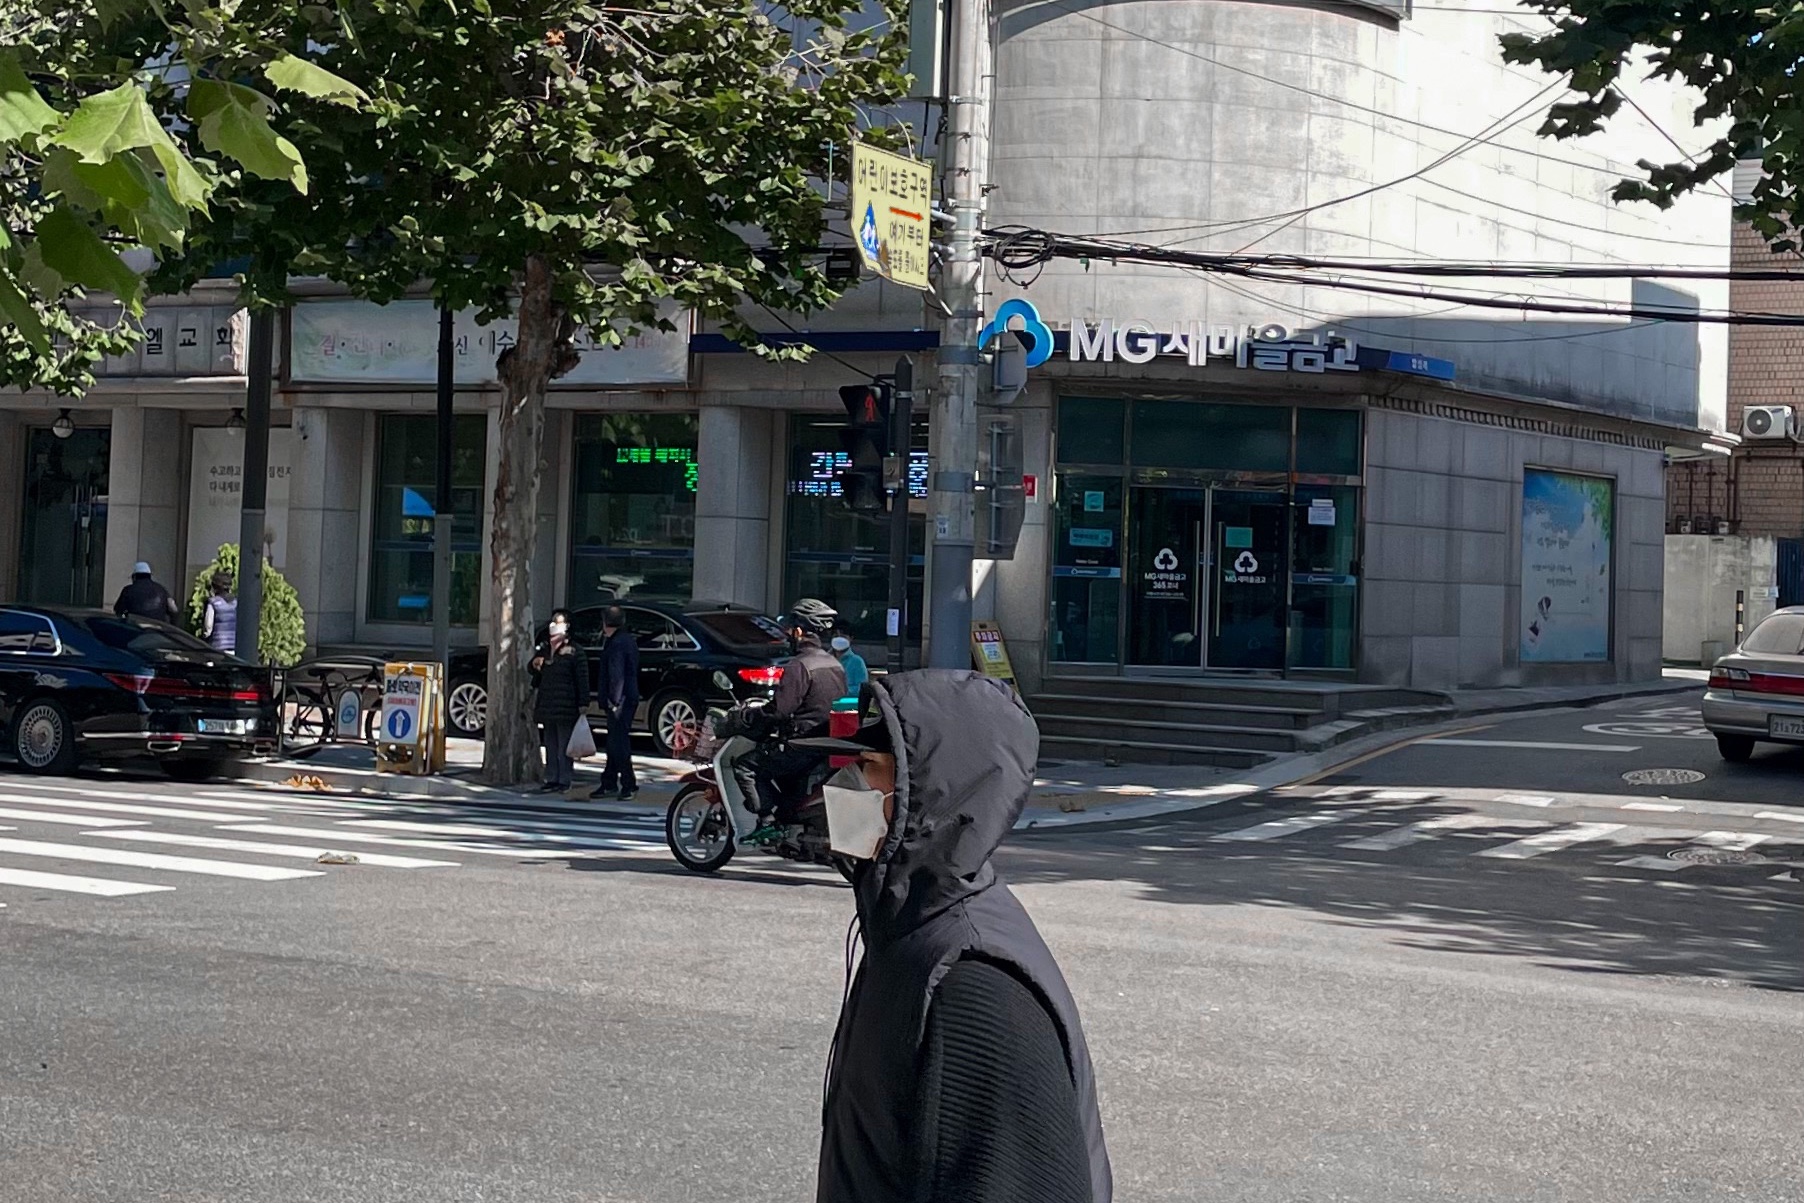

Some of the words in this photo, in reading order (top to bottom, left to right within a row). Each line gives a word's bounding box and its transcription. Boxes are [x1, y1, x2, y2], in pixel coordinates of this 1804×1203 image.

[858, 157, 927, 208] 어린이보호구역
[889, 220, 924, 249] 여기부터
[1070, 317, 1360, 373] MG새마을금고
[209, 465, 241, 478] 수고하고
